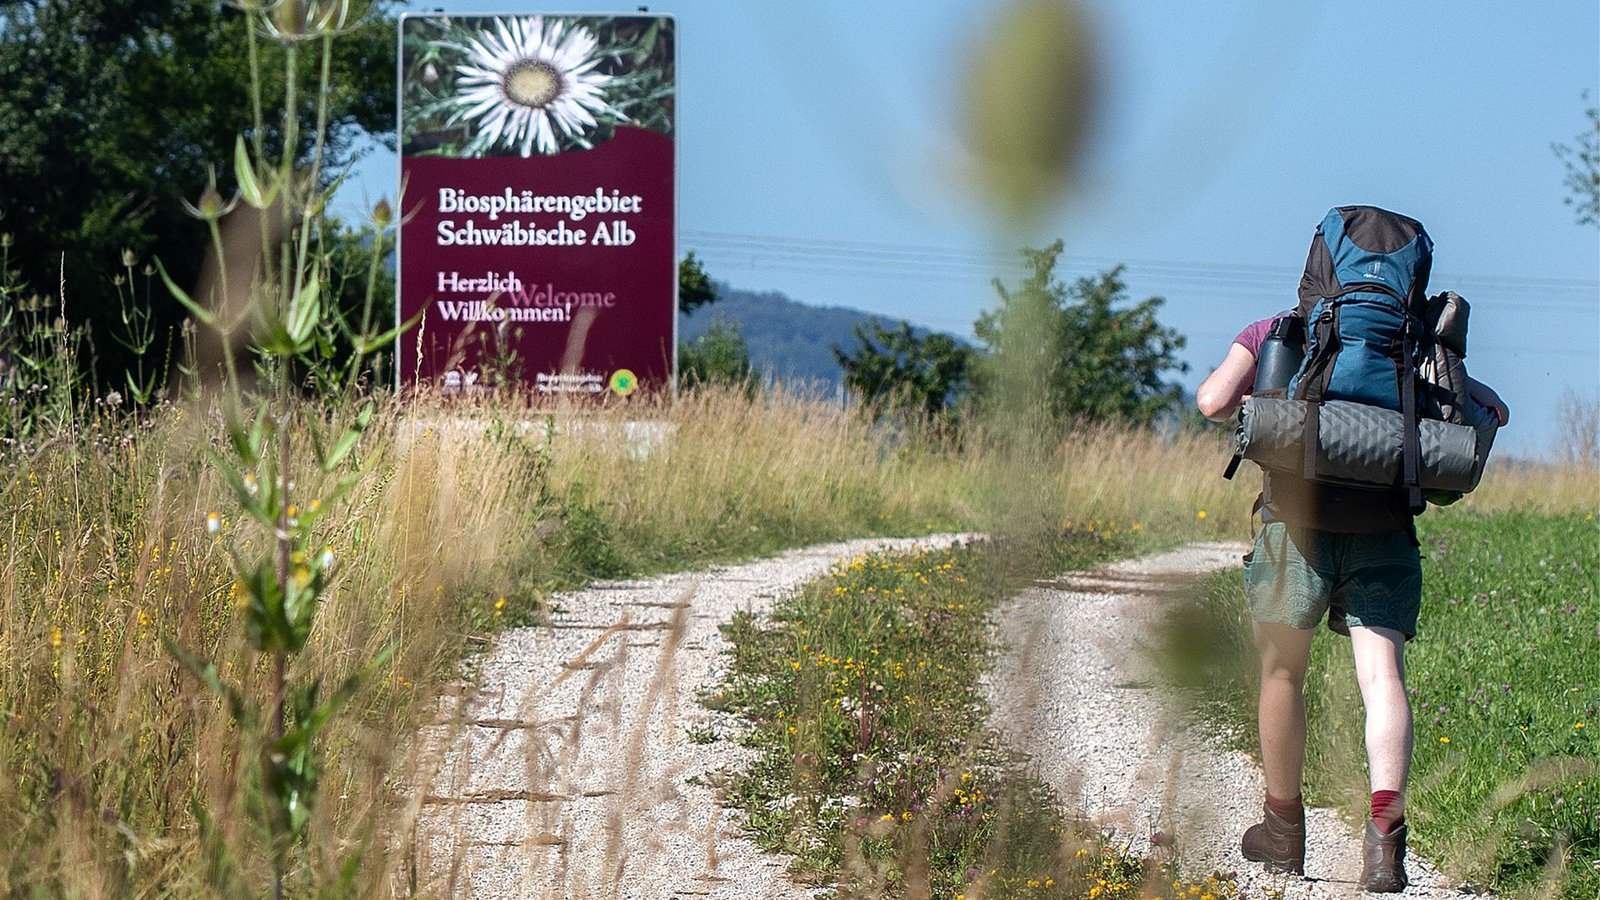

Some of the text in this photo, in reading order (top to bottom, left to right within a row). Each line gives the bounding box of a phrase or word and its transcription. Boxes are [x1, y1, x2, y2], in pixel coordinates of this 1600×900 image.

[438, 186, 643, 221] Biosphärengebiet
[437, 219, 636, 246] Schwäbische Alb
[437, 270, 522, 293] Herzlich
[509, 283, 616, 308] Welcome
